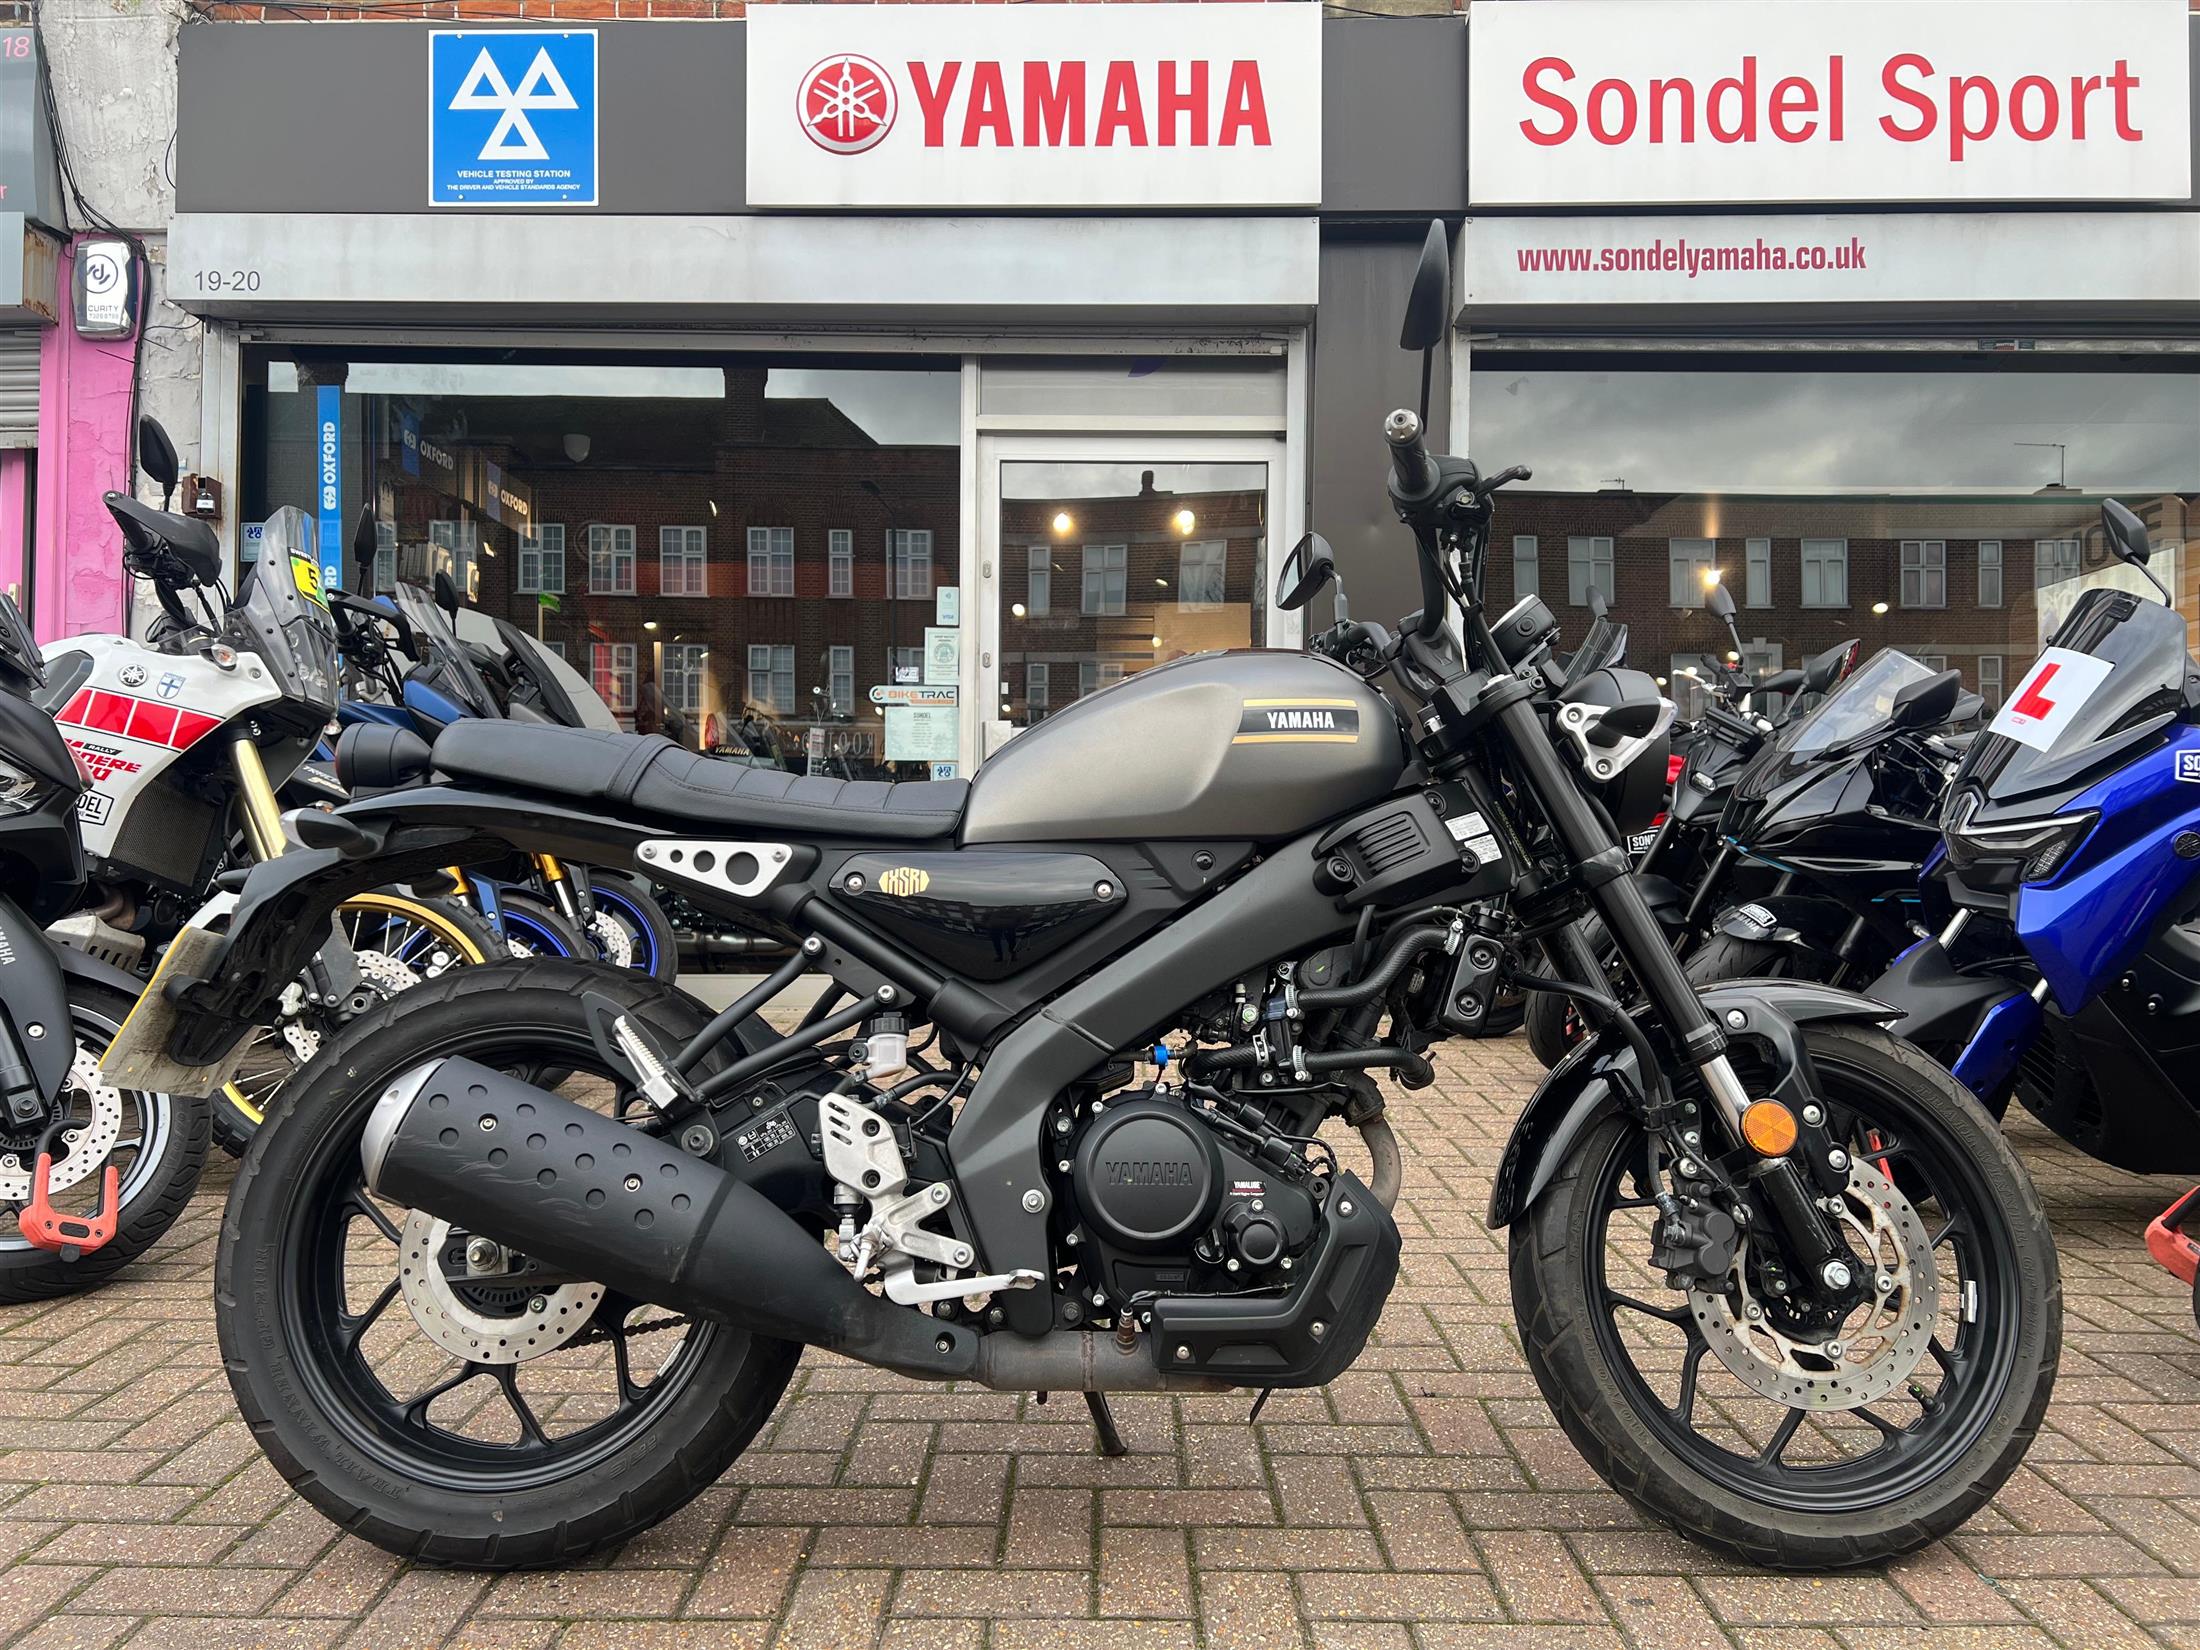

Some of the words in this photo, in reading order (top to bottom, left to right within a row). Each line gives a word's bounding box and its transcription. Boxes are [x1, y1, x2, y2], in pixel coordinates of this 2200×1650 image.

[3, 36, 30, 58] 18
[906, 60, 1272, 147] YAMAHA
[1519, 55, 1844, 145] Sondel
[1878, 53, 2143, 162] Sport
[457, 170, 493, 178] VEHICLE
[495, 170, 531, 178] TESTING
[533, 170, 571, 178] STATION
[1517, 237, 1867, 278] www.sondelyamaha.co.uk
[194, 270, 261, 292] 19-20
[323, 421, 337, 485] OXFORD
[419, 439, 454, 471] OXFORD
[500, 488, 528, 516] OXFORD
[308, 567, 318, 590] 5
[888, 690, 954, 699] BIKETRAC
[2012, 662, 2061, 721] L
[1267, 711, 1335, 730] YAMAHA
[88, 744, 116, 754] RALLY
[714, 746, 750, 756] YAMAHA
[888, 866, 920, 897] XSR
[1105, 1161, 1193, 1186] YAMAHA
